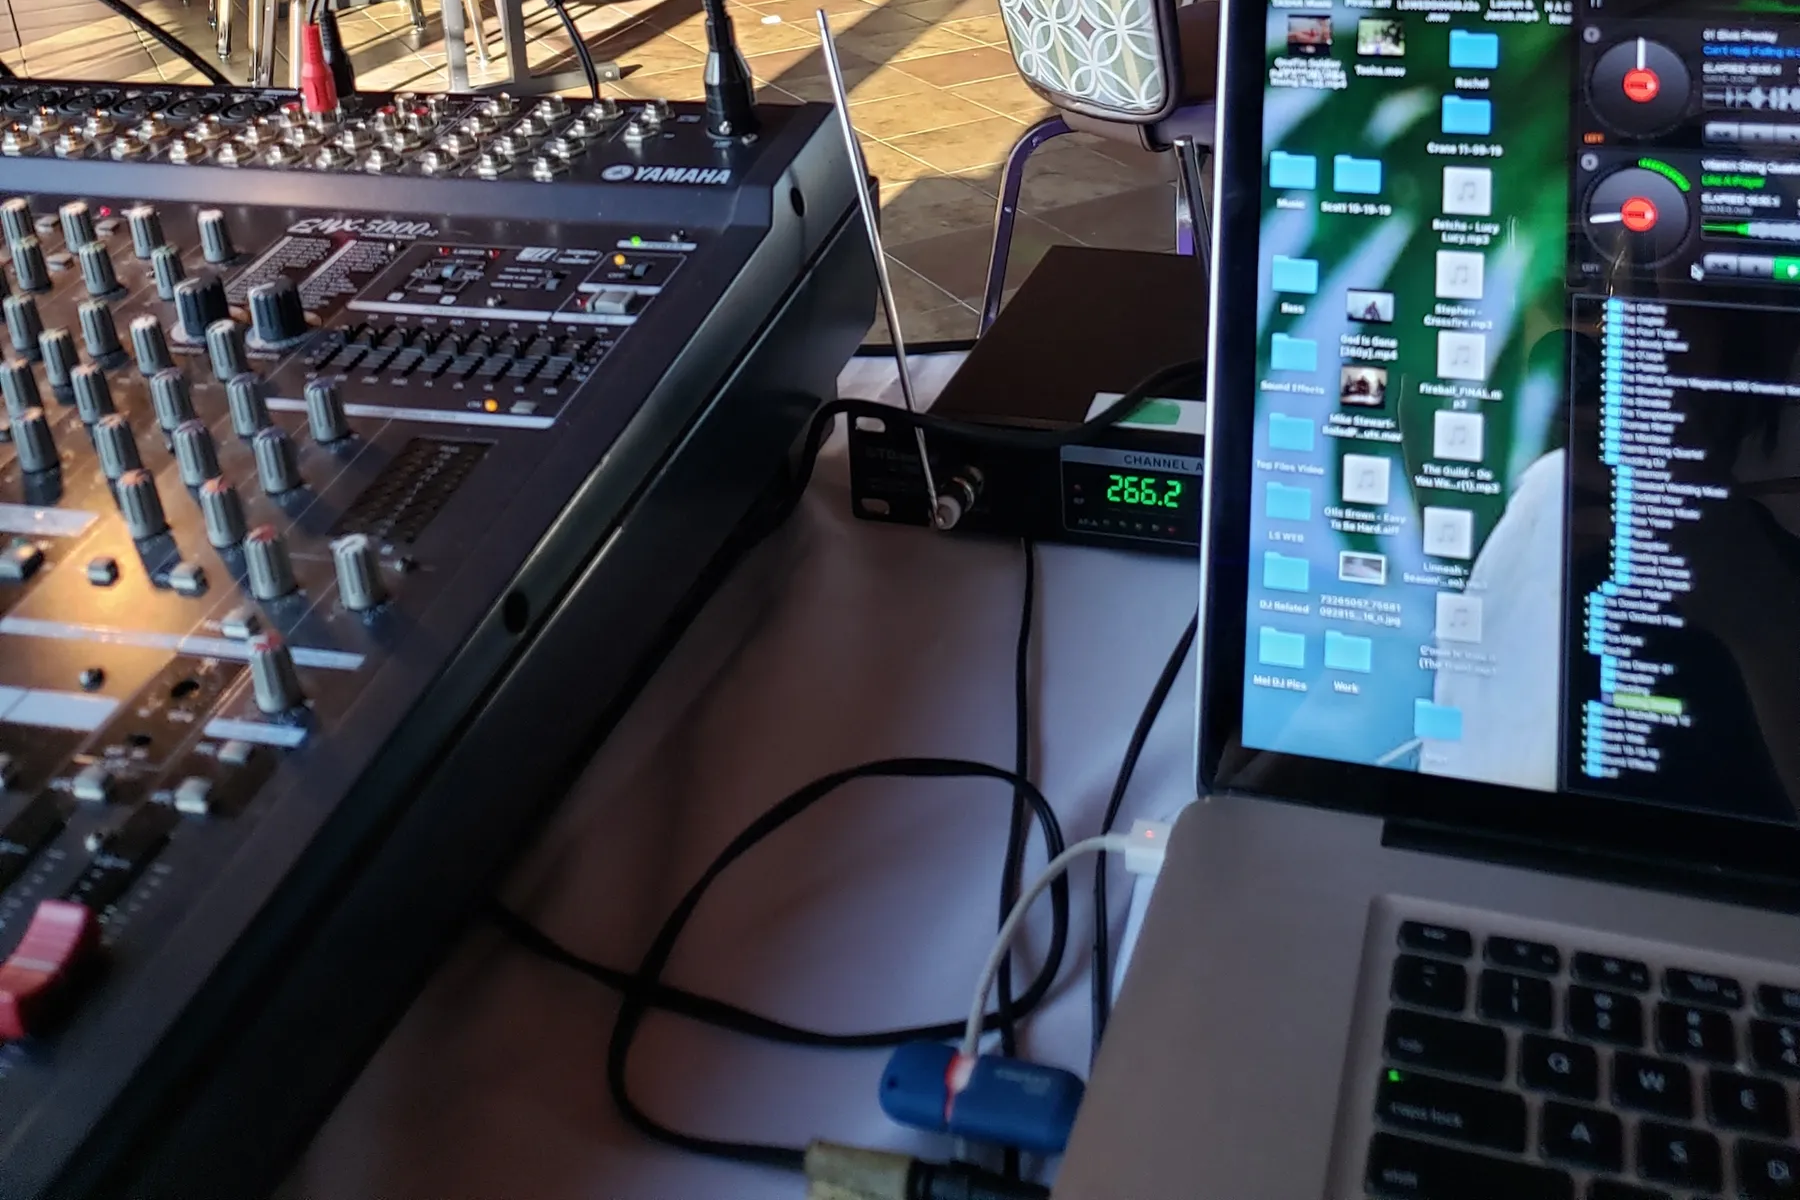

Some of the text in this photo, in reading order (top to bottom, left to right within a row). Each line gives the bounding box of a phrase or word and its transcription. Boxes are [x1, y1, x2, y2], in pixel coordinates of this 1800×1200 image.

[634, 166, 731, 184] YAMAHA
[1329, 414, 1352, 426] Mike
[1124, 454, 1189, 471] CHANNEL
[1422, 463, 1442, 475] The
[1107, 474, 1182, 508] 266.2
[1333, 680, 1360, 695] Work
[1638, 1069, 1666, 1093] W
[1570, 1121, 1592, 1144] A
[1669, 1140, 1689, 1163] S
